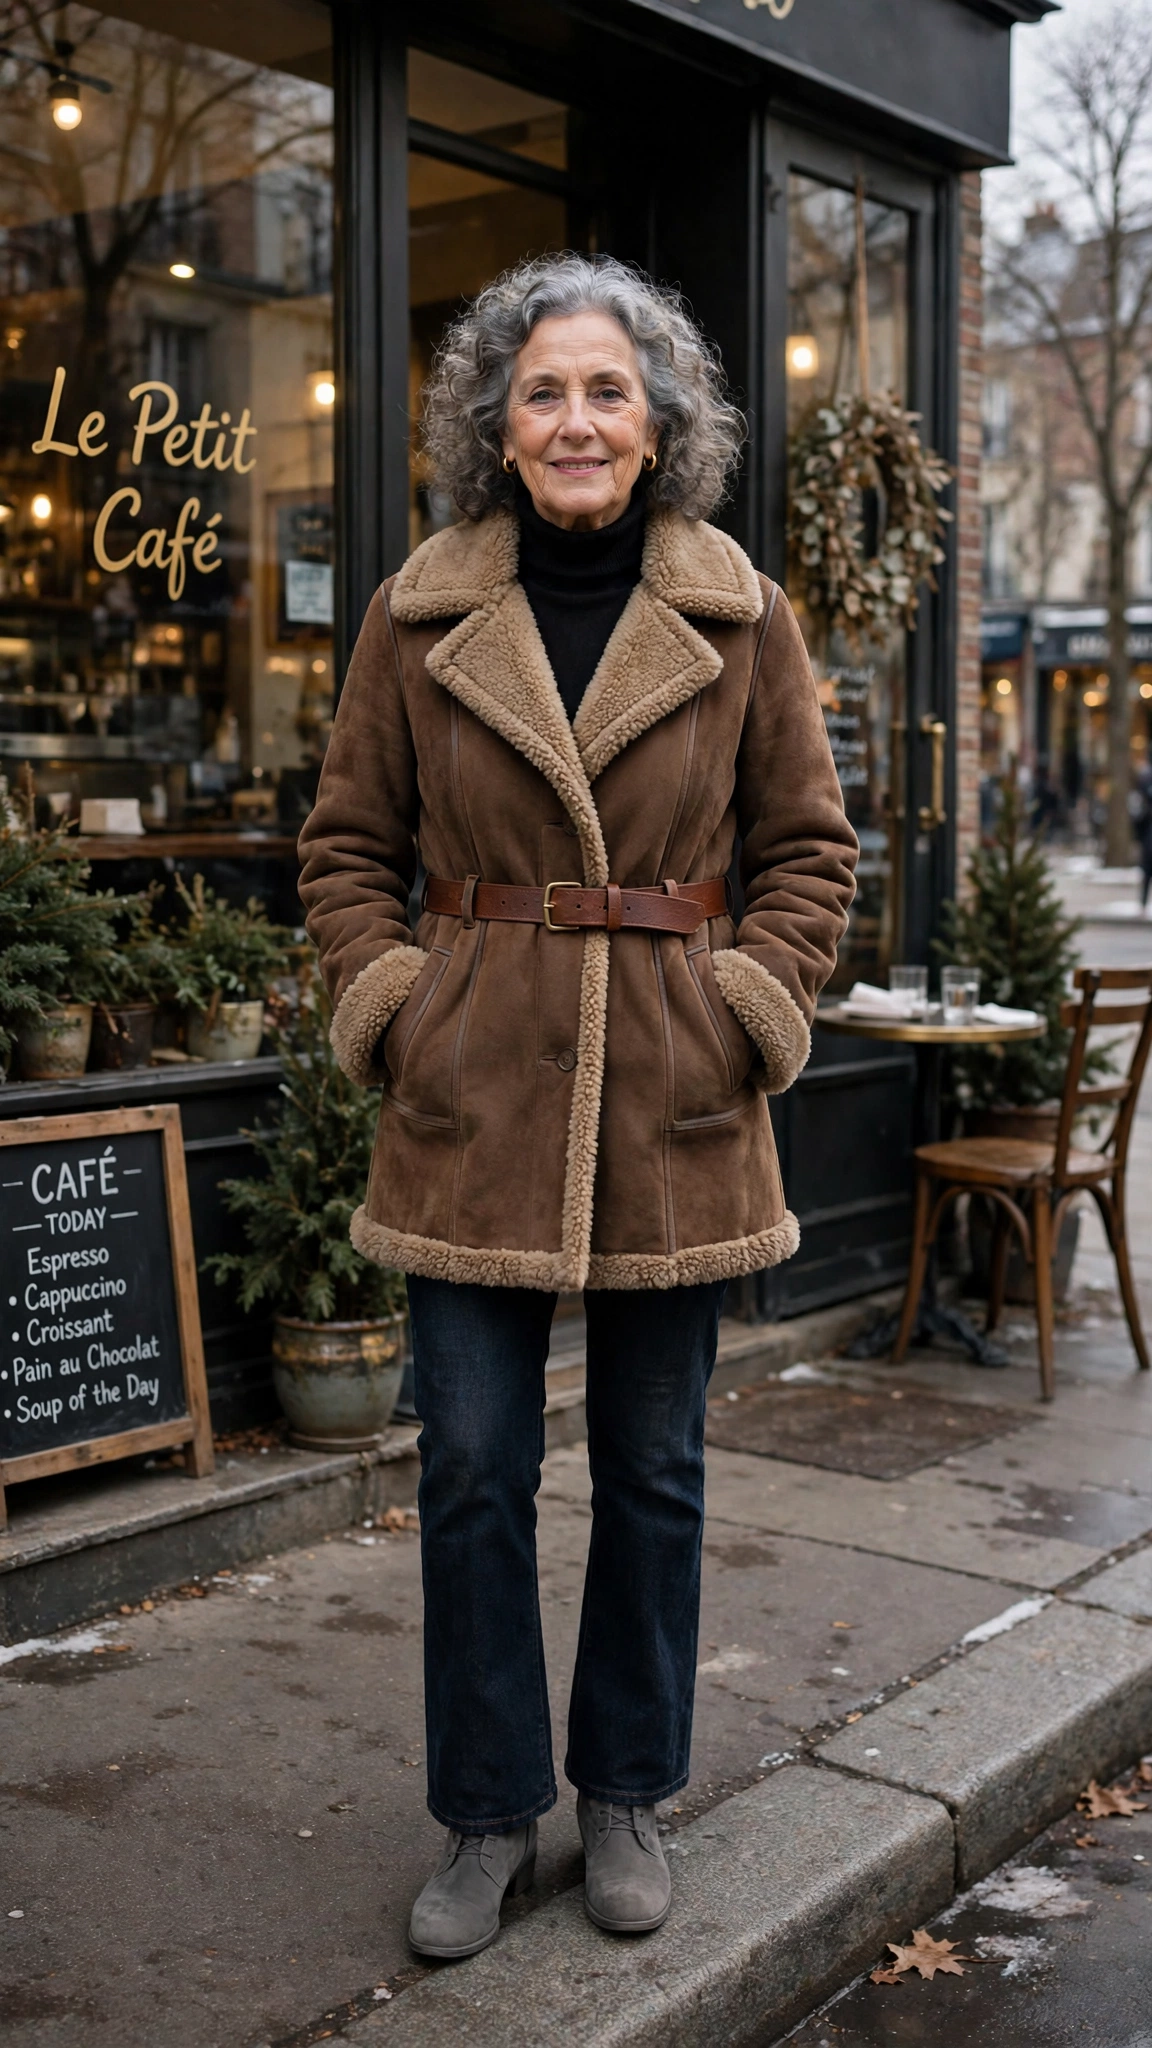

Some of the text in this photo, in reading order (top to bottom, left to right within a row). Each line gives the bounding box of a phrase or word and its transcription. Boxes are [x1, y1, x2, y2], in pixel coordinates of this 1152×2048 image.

[32, 366, 257, 474] Le Petit
[93, 487, 223, 601] Café
[31, 1146, 119, 1205] CAFÉ
[45, 1206, 107, 1235] TODAY
[27, 1247, 109, 1281] Espresso
[25, 1277, 127, 1315] Cappuccino
[27, 1309, 115, 1347] Croissant
[13, 1335, 160, 1386] Pain au Chocolat
[16, 1373, 160, 1423] Soup of the Day
